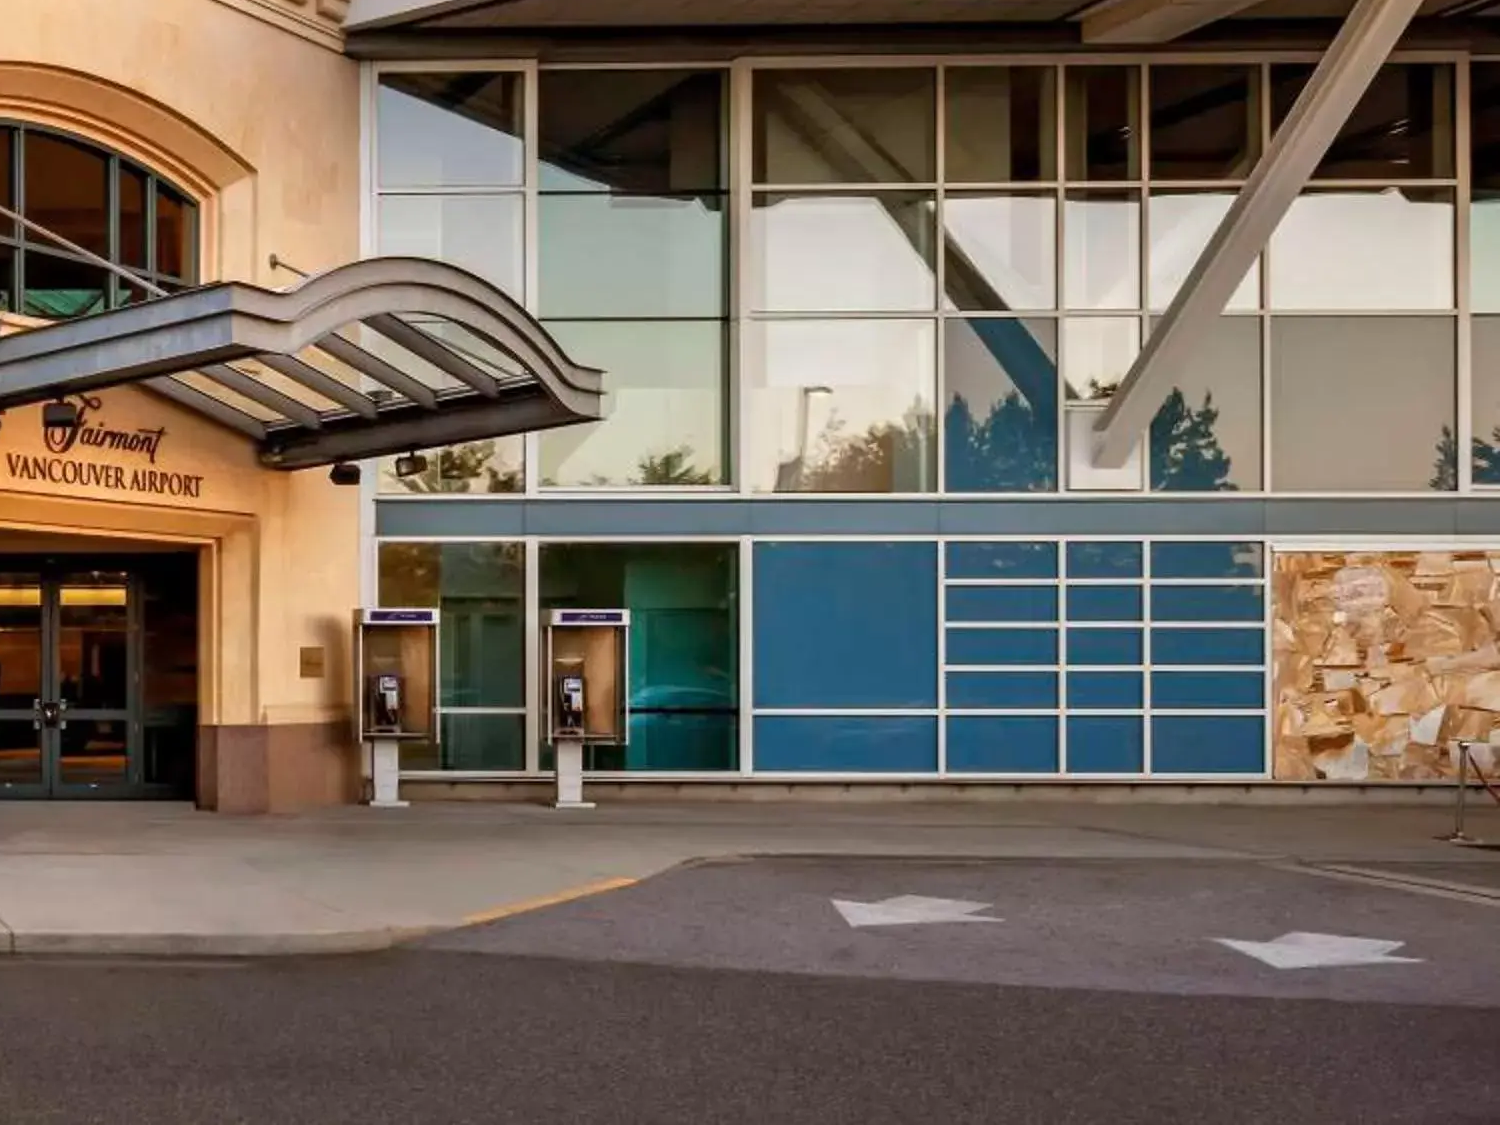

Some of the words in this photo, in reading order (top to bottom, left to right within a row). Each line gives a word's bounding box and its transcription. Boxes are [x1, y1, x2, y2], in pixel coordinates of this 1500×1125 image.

[43, 394, 166, 464] Fairmont
[6, 453, 126, 490] VANCOUVER
[130, 470, 205, 498] AIRPORT
